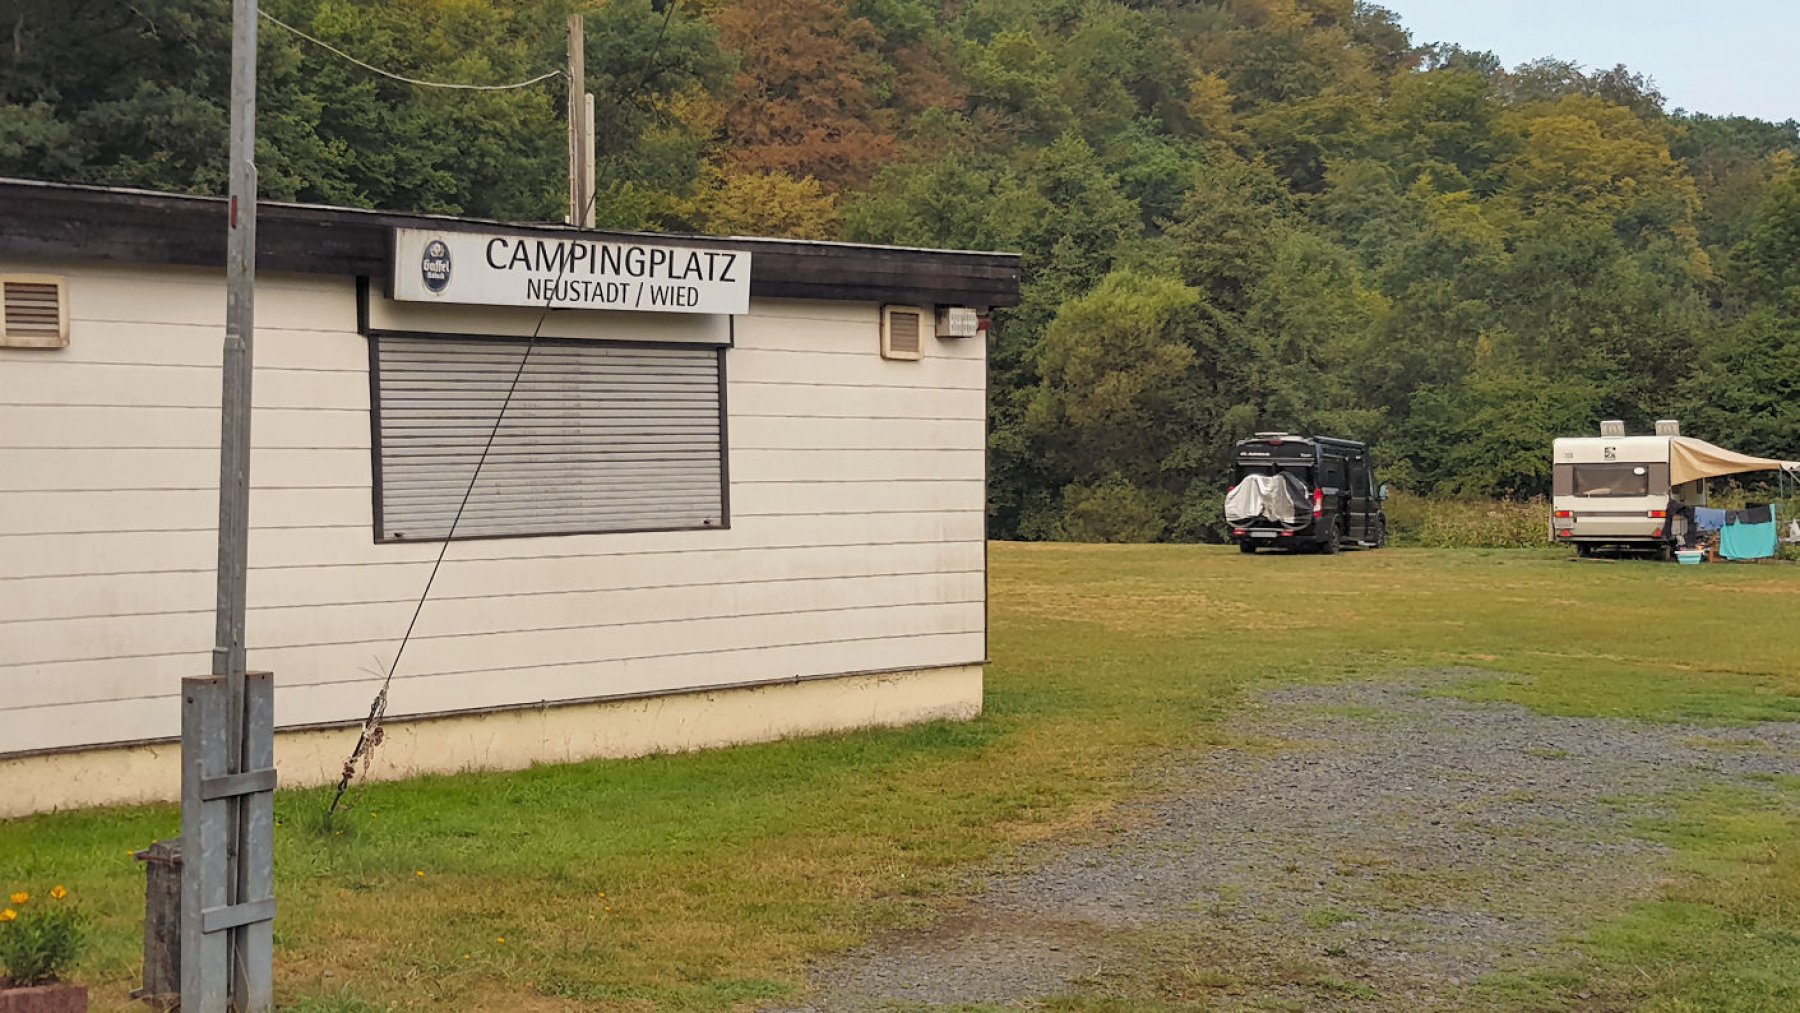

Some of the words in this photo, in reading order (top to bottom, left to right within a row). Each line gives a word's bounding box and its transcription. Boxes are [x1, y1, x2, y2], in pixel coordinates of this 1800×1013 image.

[423, 258, 450, 273] Gaffel
[486, 238, 736, 282] CAMPINGPLATZ
[527, 278, 630, 304] NEUSTADT
[635, 281, 644, 308] /
[651, 285, 700, 307] WIED
